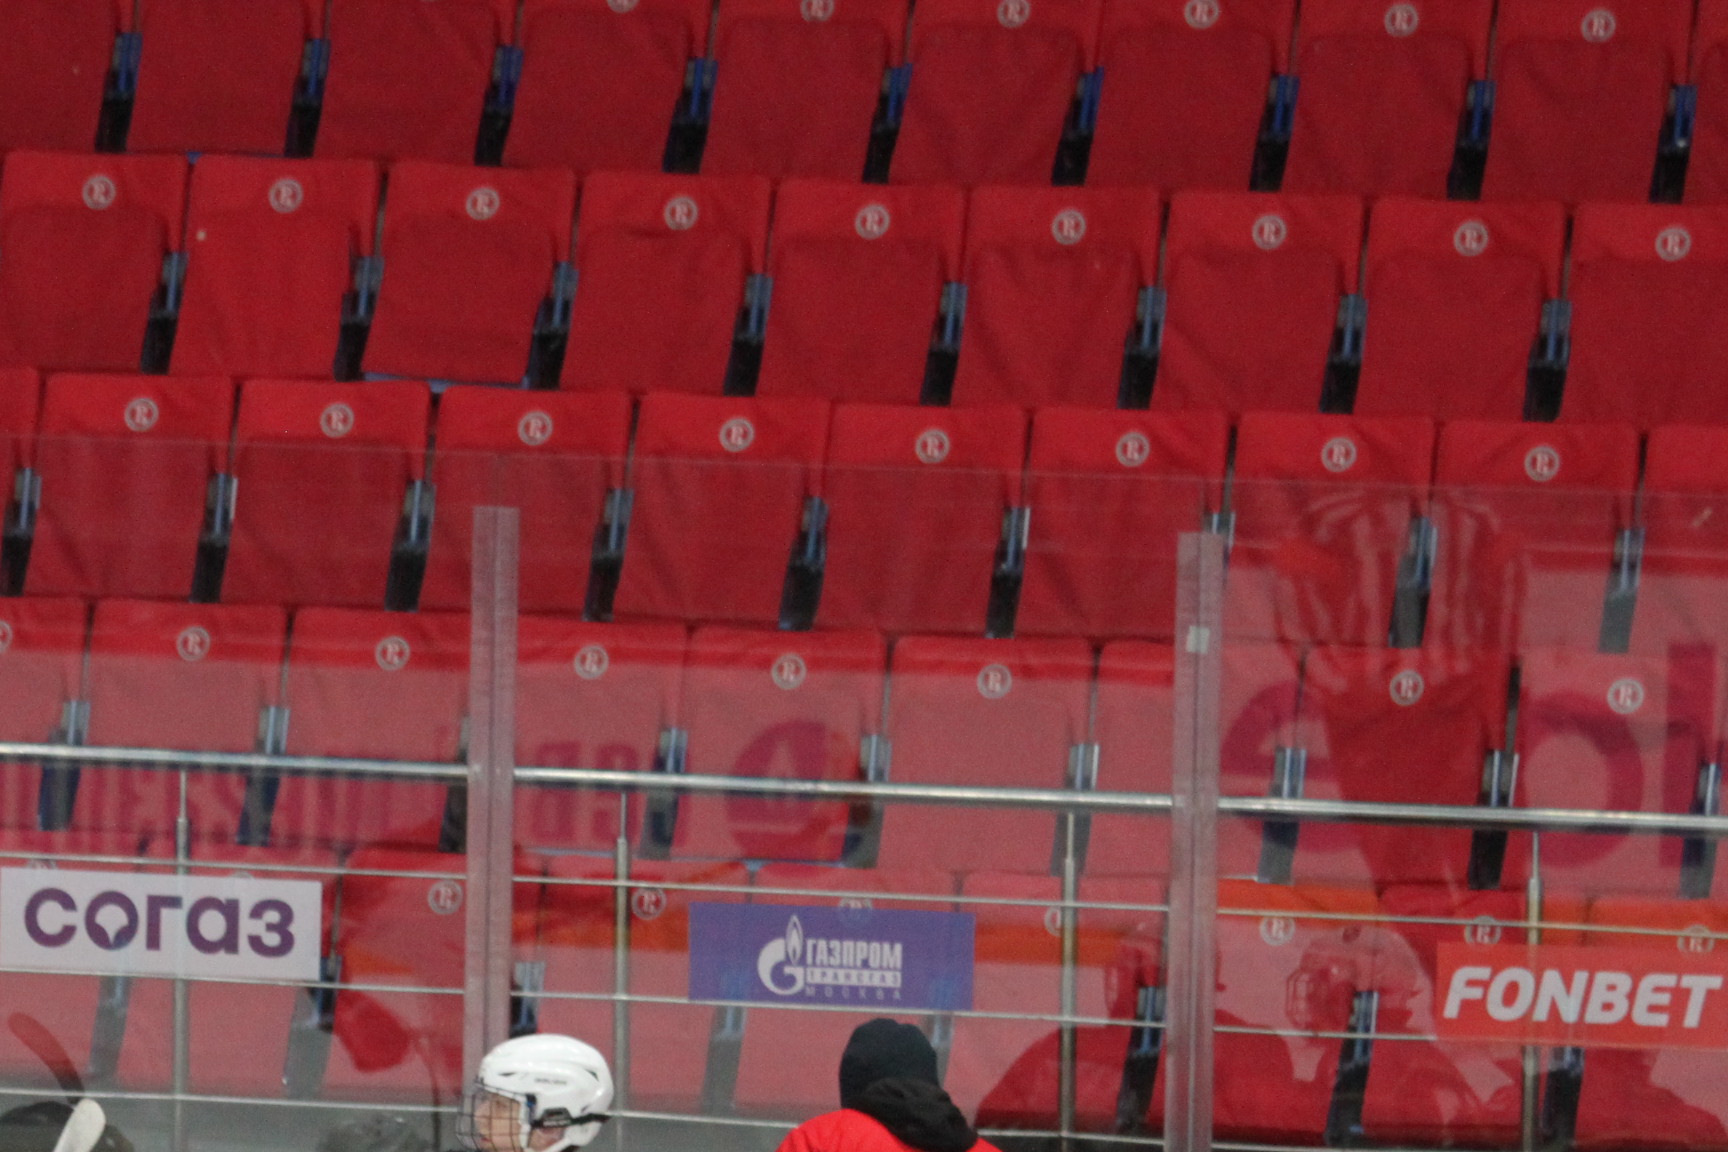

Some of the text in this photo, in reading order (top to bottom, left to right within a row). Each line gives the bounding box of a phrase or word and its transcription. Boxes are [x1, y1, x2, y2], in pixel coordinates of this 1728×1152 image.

[806, 939, 902, 969] ГАЗПРОМ
[805, 985, 901, 1000] МОСКВА
[1443, 964, 1722, 1030] FONBET
